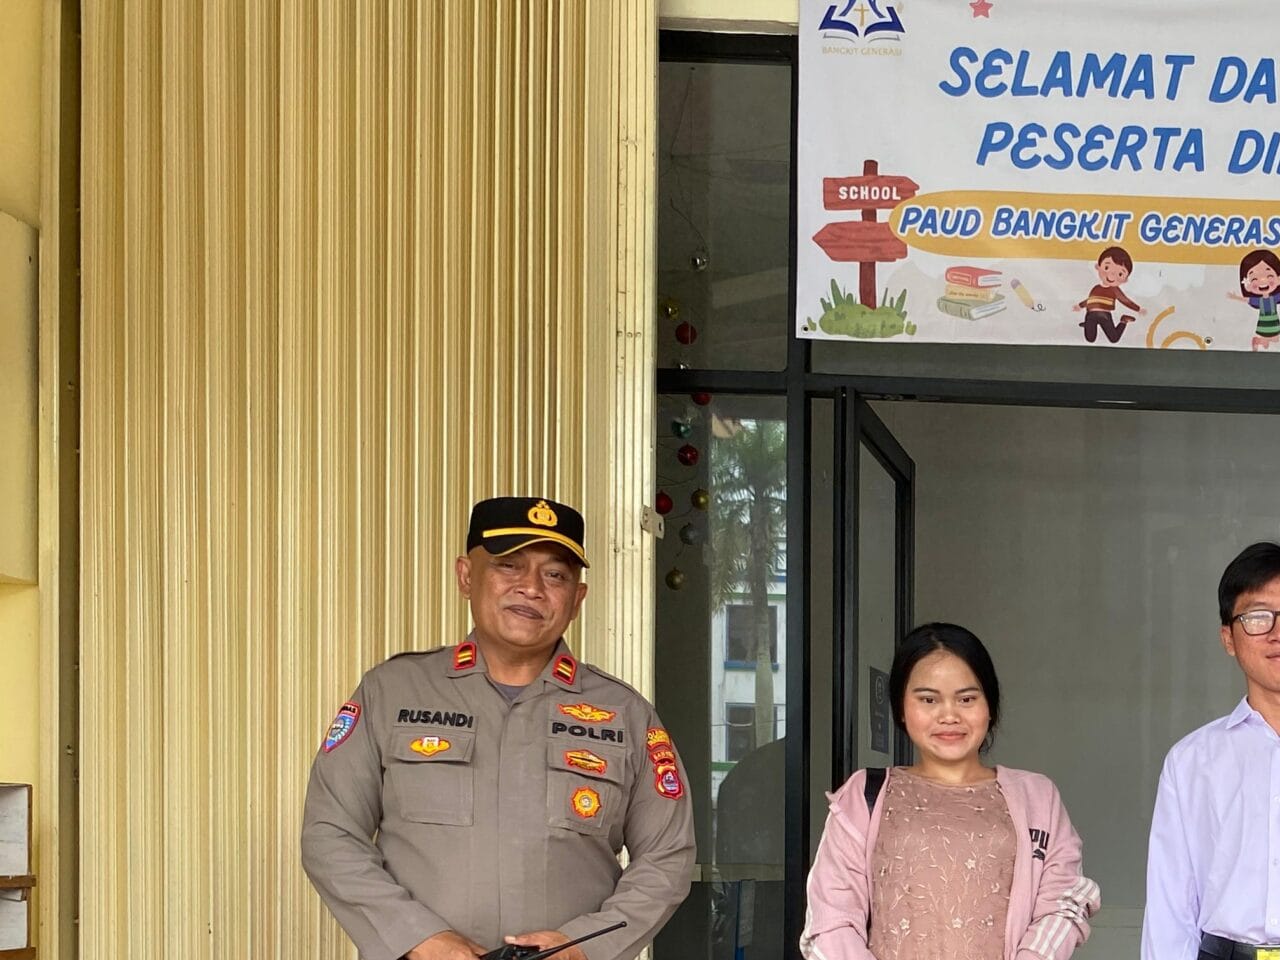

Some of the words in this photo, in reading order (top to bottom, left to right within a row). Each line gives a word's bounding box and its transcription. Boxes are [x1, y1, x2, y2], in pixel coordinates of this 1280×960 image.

[938, 46, 1195, 99] SELAMAT
[975, 121, 1205, 172] PESERTA
[838, 186, 901, 200] SCHOOL
[899, 206, 982, 237] PAUD
[991, 209, 1131, 242] BANGKIT
[397, 708, 474, 729] RUSANDI
[551, 721, 624, 743] POLRI
